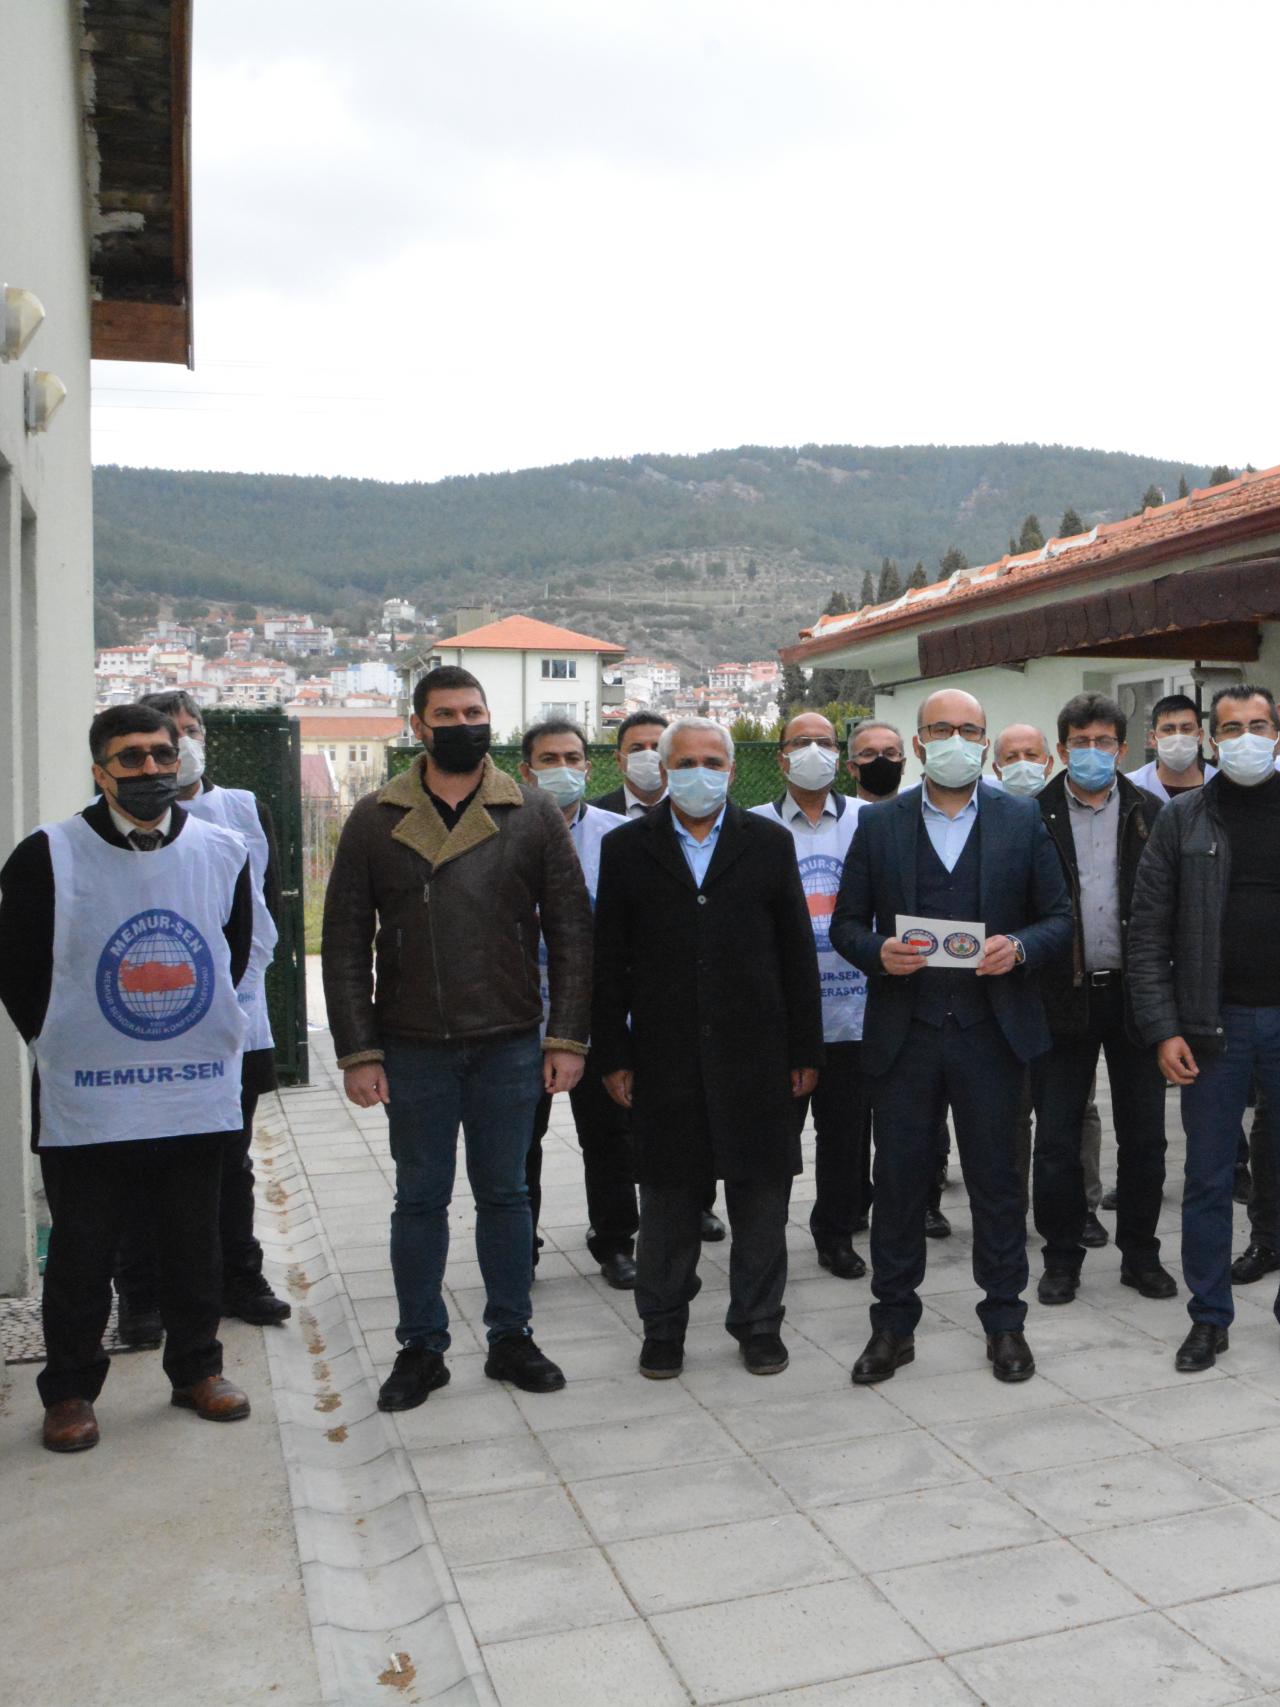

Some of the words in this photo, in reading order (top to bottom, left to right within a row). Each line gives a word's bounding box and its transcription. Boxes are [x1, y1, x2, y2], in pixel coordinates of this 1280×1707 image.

[110, 915, 203, 957] MEMUR-SEN
[820, 970, 861, 982] UR-SEN
[74, 1060, 225, 1087] MEMUR-SEN
